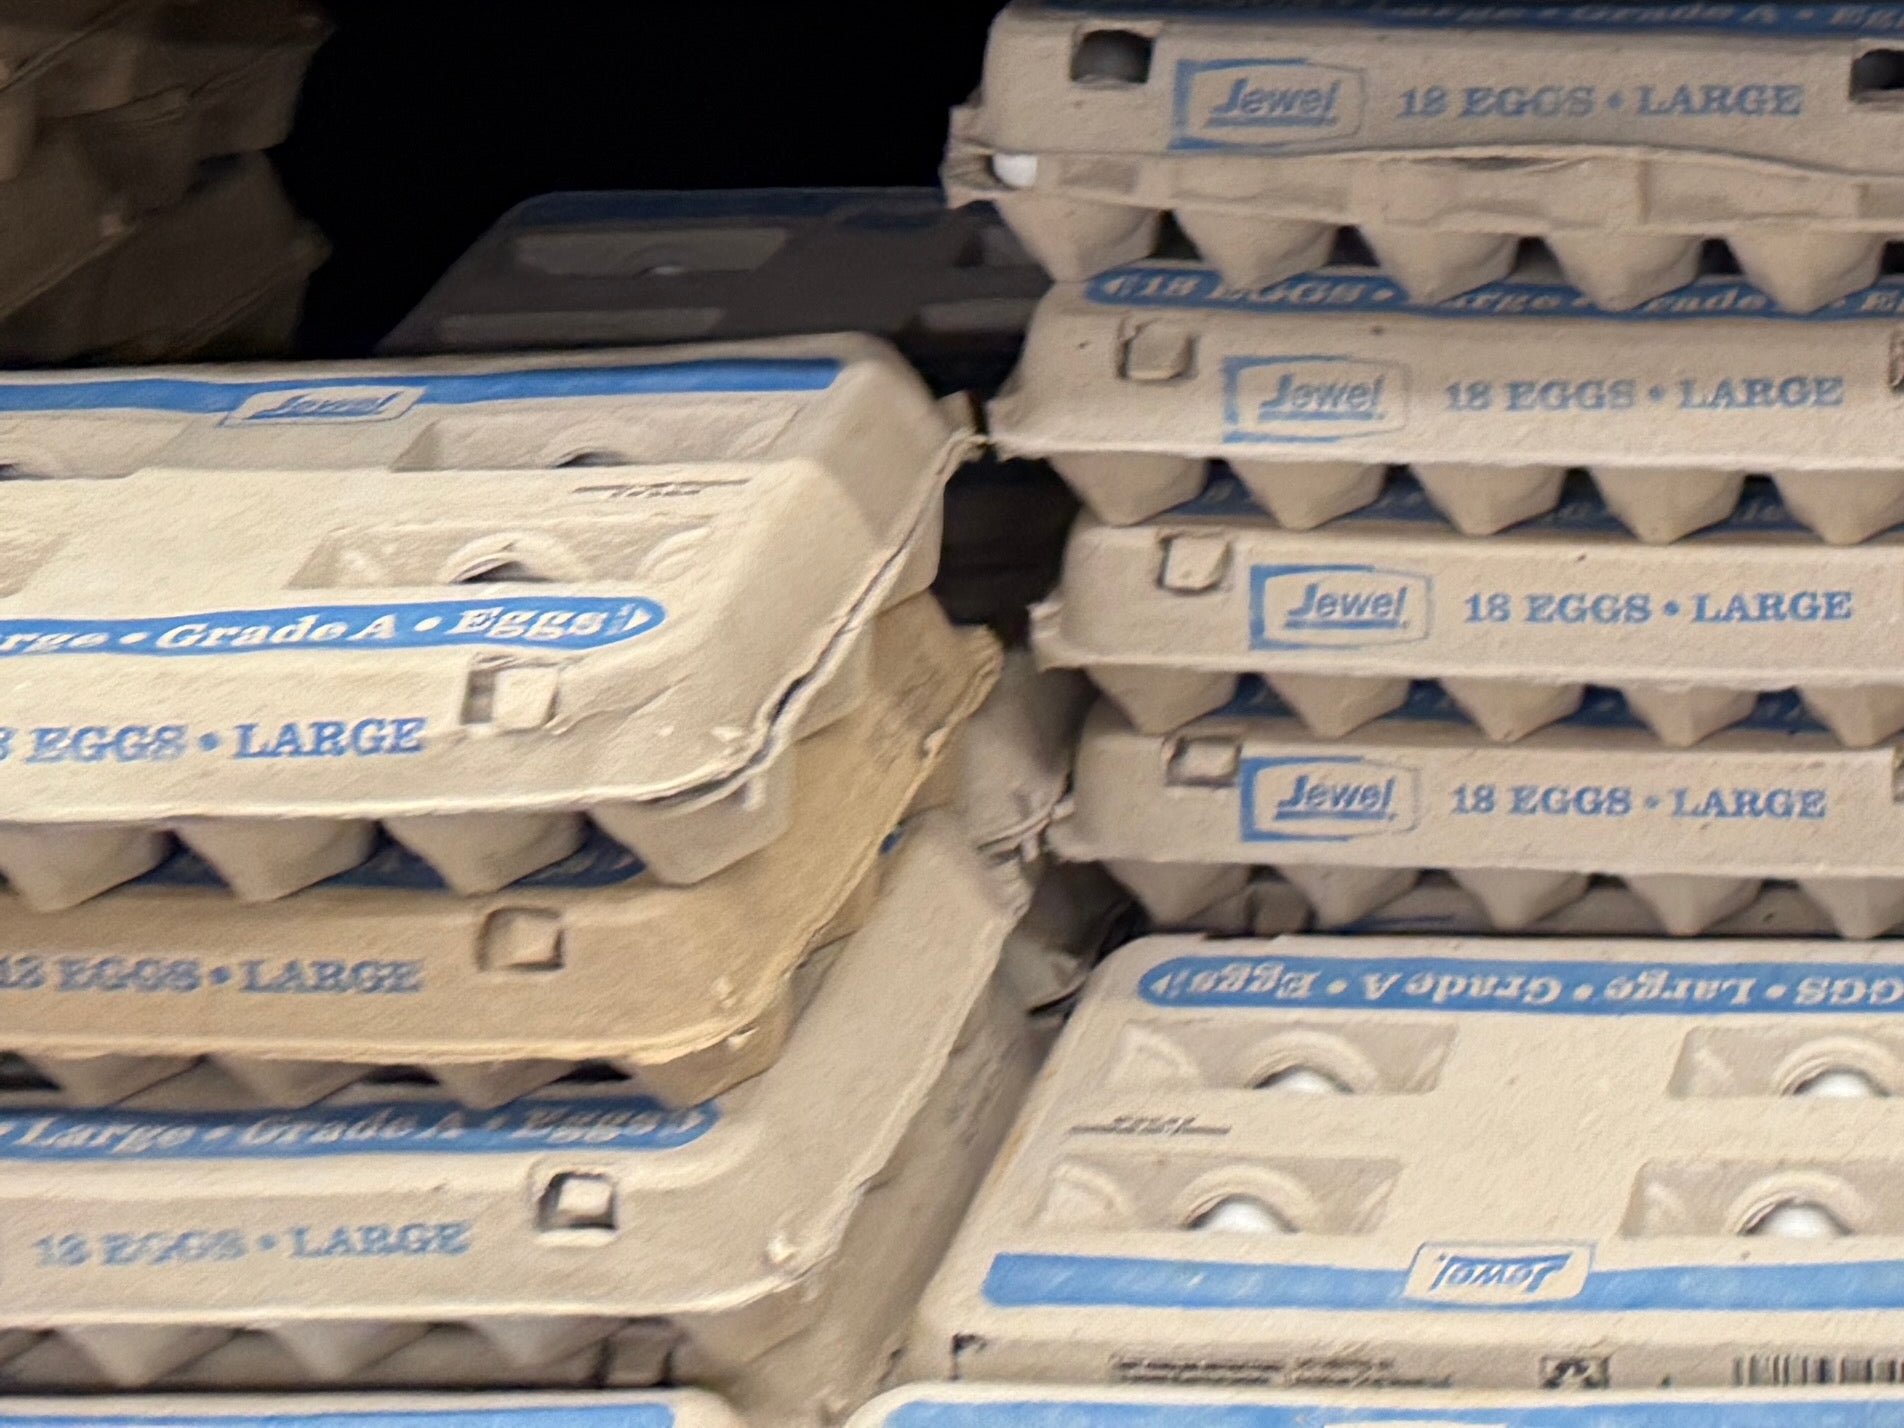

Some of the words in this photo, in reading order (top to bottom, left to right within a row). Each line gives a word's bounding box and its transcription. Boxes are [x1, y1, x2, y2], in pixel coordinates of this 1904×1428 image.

[1287, 583, 1408, 619] Jewel
[1463, 592, 1511, 624] 18
[1523, 593, 1652, 624] EGGS
[1690, 590, 1852, 623] LARGE
[159, 614, 351, 647] Grade
[355, 612, 397, 641] A
[445, 605, 600, 644] Eggs
[24, 724, 188, 764] EGGS
[231, 716, 429, 759] LARGE
[1192, 964, 1315, 1000] Eggs
[1356, 968, 1398, 1002] A
[1405, 968, 1563, 1006] Grade
[1603, 970, 1757, 1010] Large
